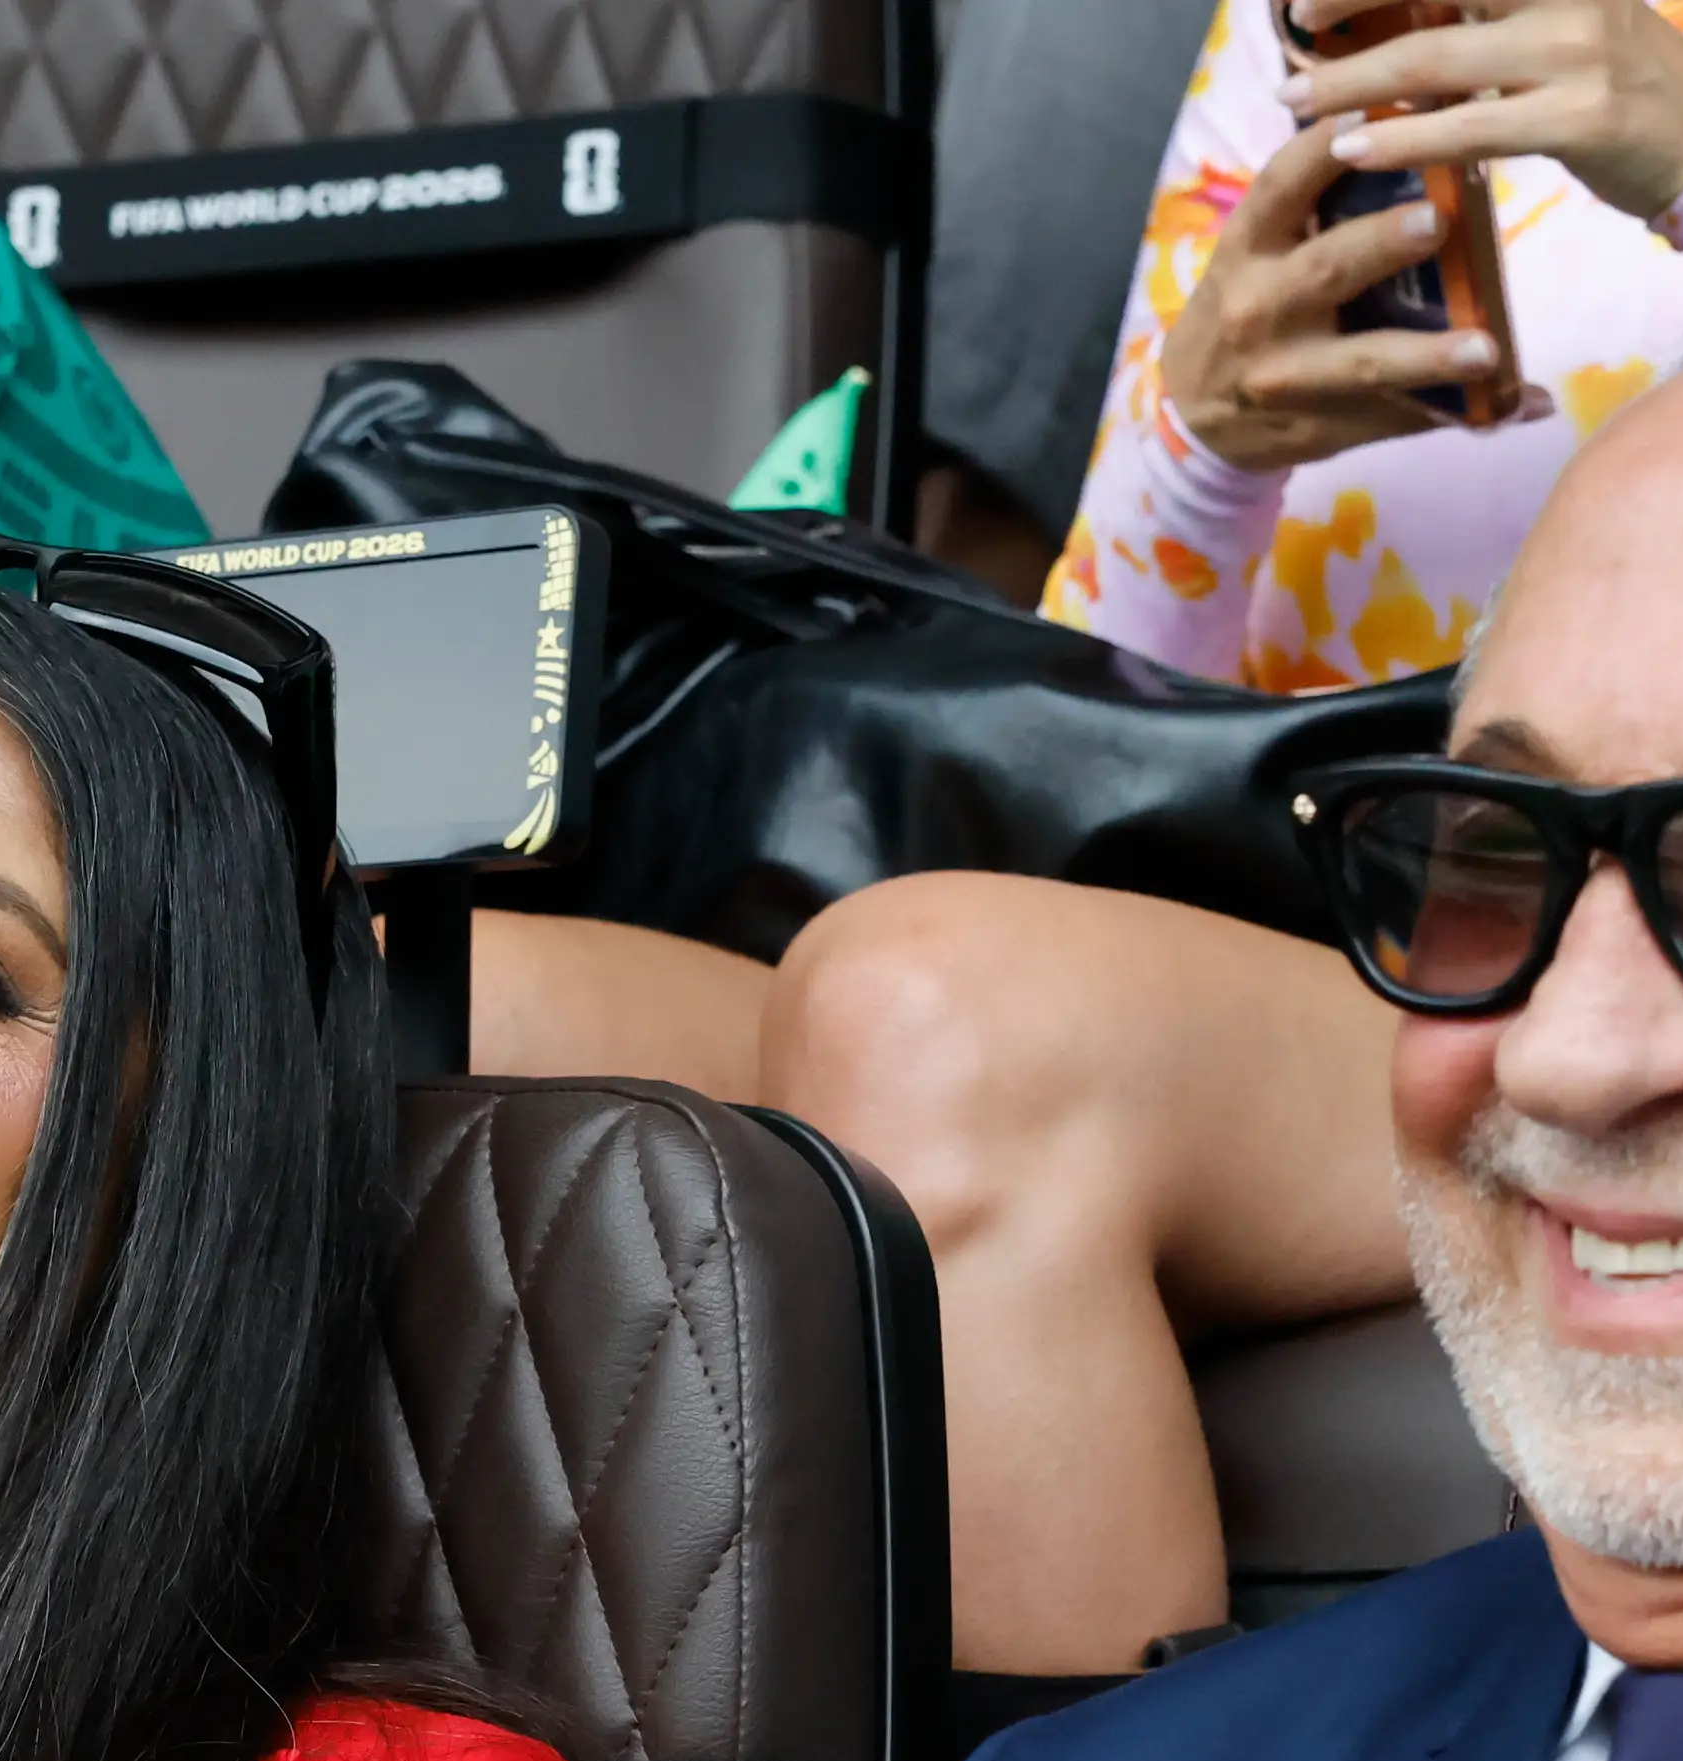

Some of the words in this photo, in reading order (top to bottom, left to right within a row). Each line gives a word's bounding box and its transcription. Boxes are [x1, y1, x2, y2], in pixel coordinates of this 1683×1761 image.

[109, 198, 185, 239] FIFA
[185, 185, 307, 230] WORLD
[308, 177, 379, 219] CUP
[378, 164, 507, 211] 2026
[223, 543, 302, 573] WORLD
[302, 539, 346, 564] CUP
[347, 531, 425, 560] 2026
